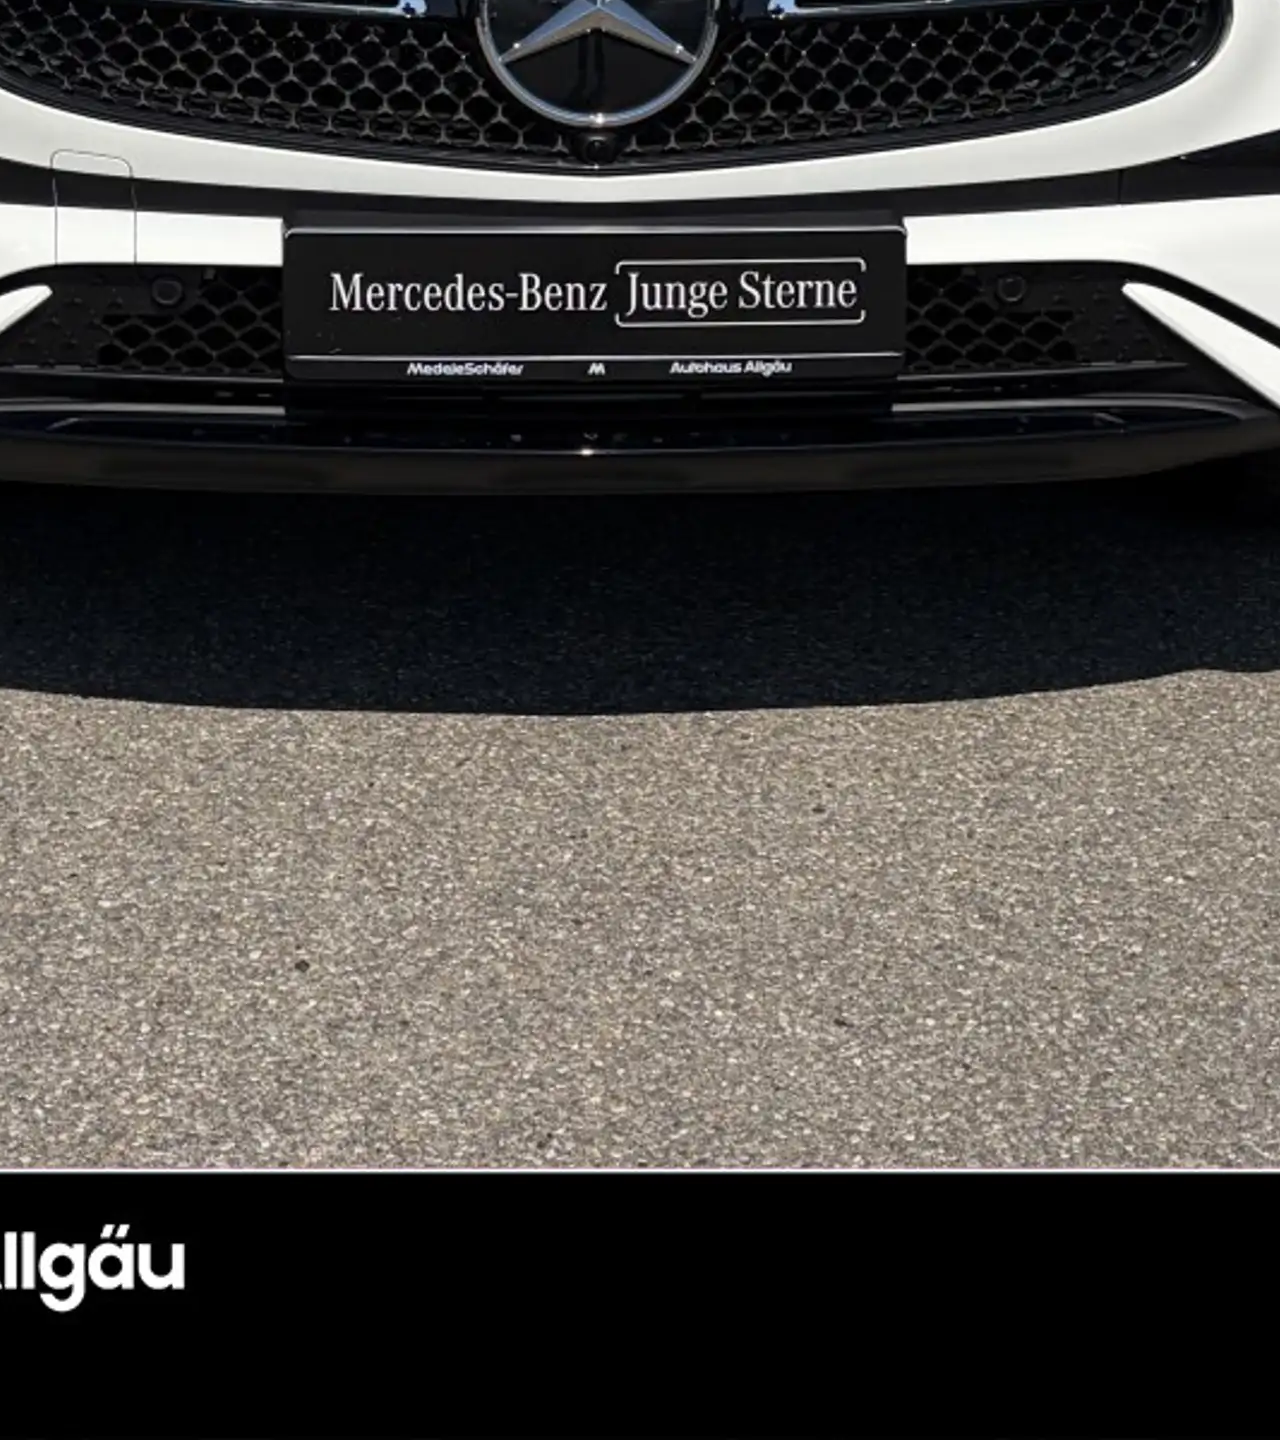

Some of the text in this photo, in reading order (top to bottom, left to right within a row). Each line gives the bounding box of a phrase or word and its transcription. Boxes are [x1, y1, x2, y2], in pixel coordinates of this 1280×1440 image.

[329, 270, 858, 318] Mercedes-Benz Junge Sterne
[407, 362, 524, 376] MedeleSchäfer
[670, 361, 742, 375] Autohaus
[744, 360, 793, 378] Allgäu
